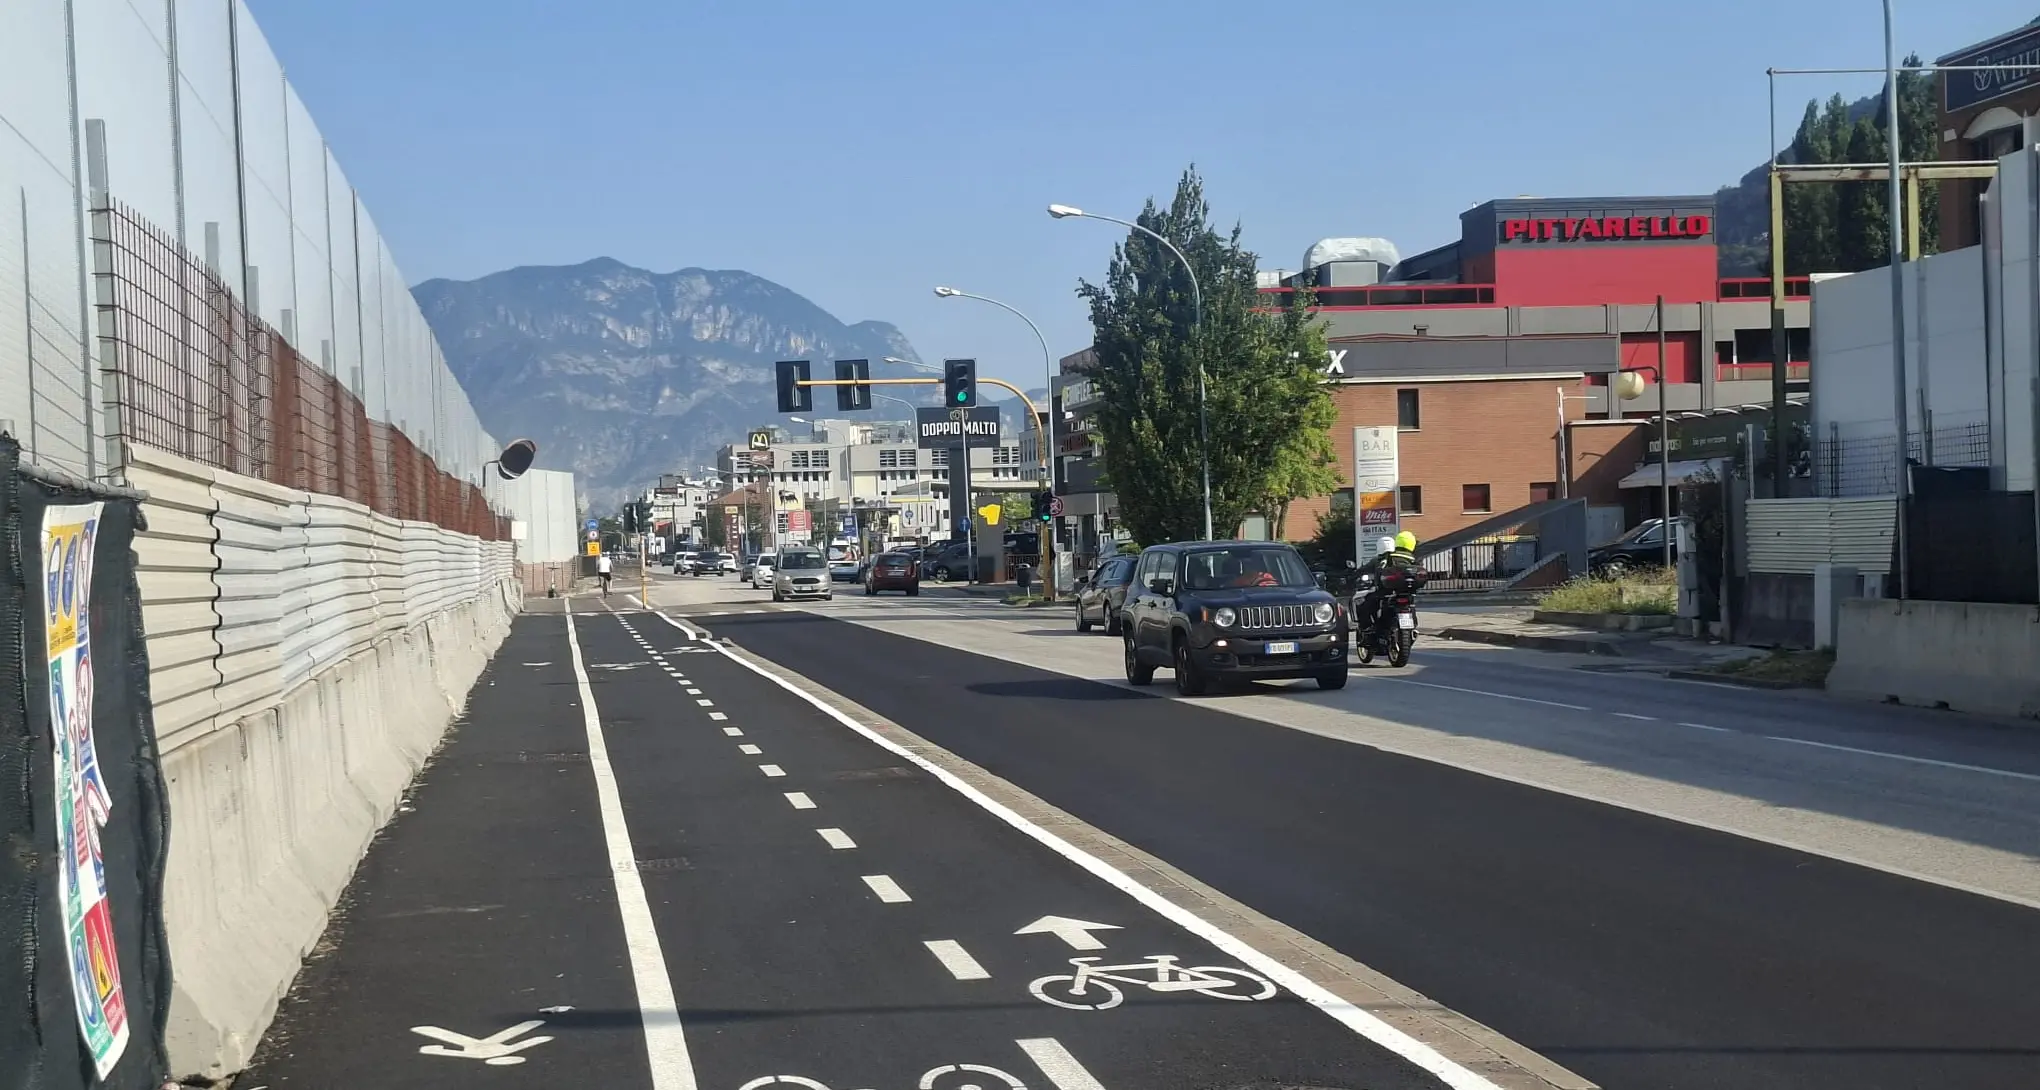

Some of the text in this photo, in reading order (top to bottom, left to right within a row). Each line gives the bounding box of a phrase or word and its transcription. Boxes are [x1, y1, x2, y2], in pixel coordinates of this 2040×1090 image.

[1506, 215, 1709, 240] PITTARELLO
[922, 421, 997, 437] DOPPIO MALTO
[1362, 440, 1390, 451] BAR
